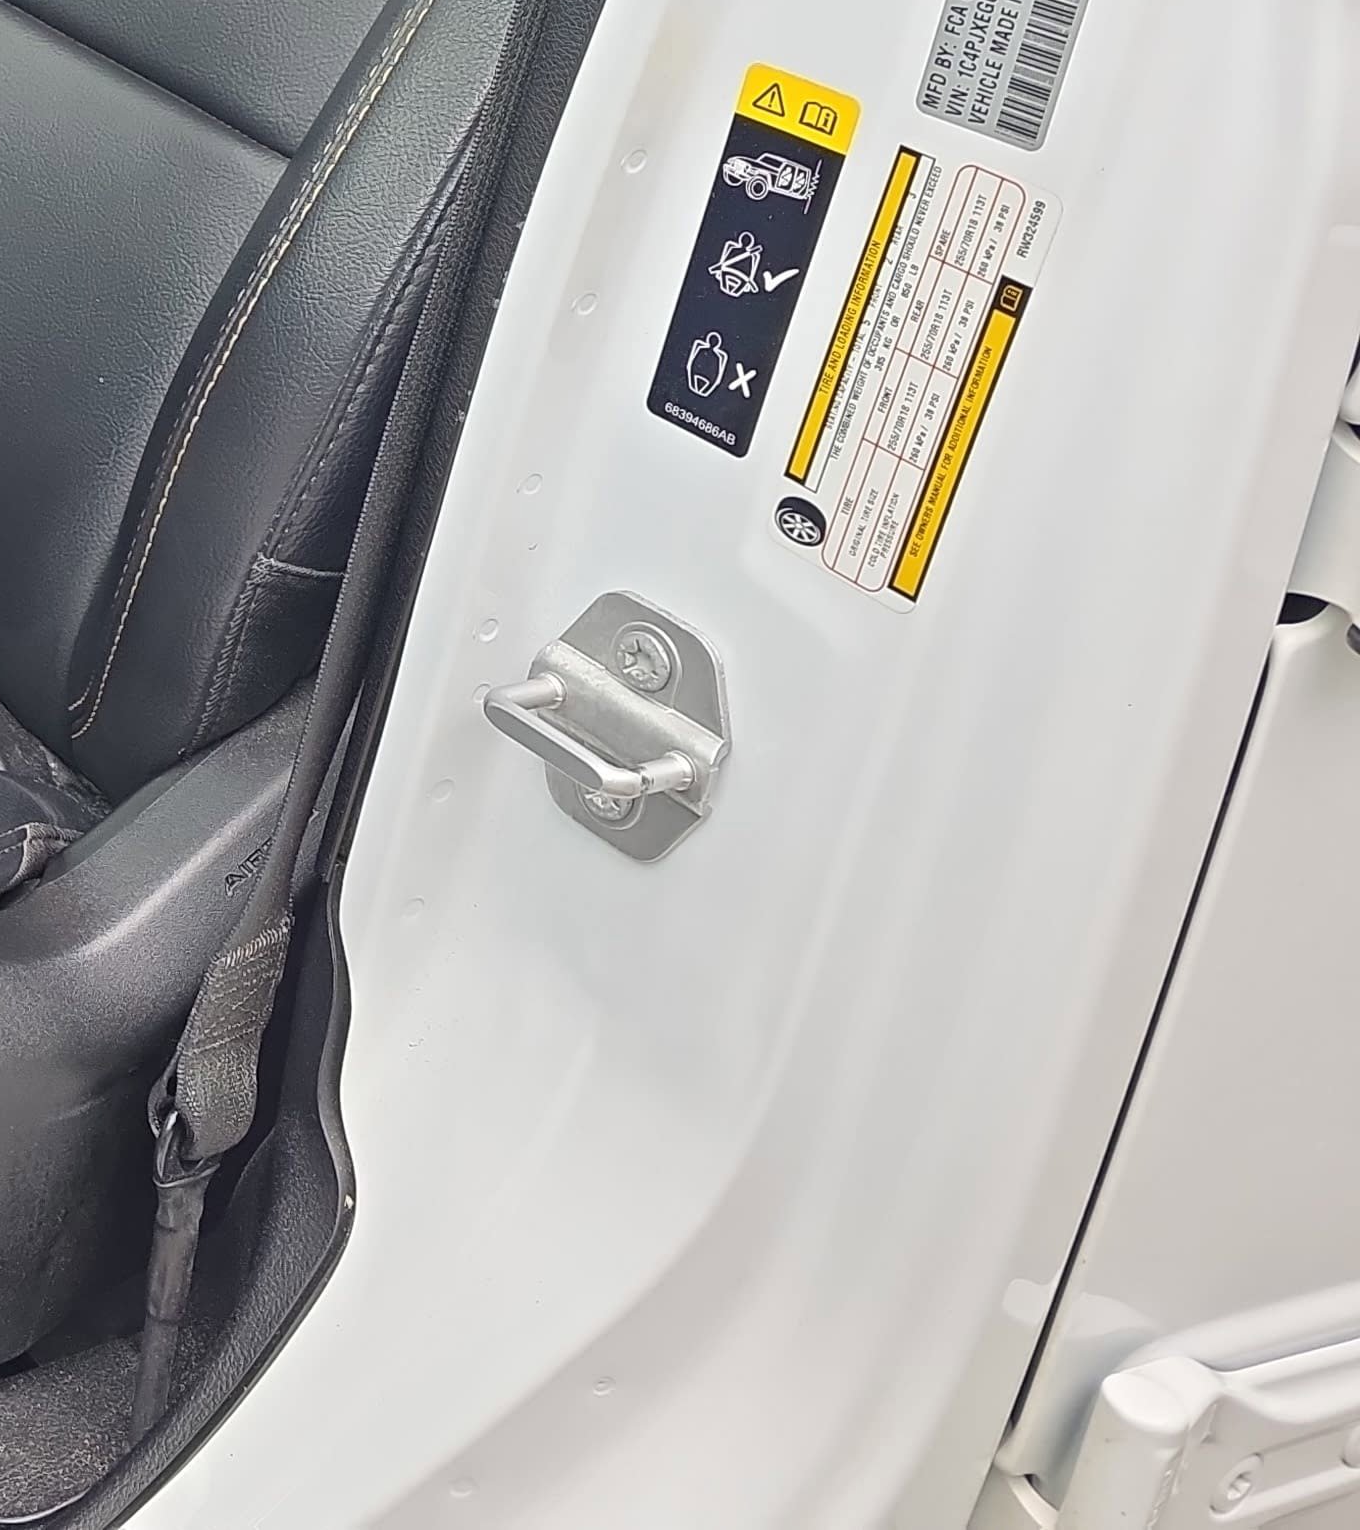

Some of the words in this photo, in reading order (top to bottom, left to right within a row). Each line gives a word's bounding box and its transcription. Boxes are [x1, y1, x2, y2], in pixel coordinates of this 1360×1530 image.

[943, 5, 969, 36] FCA
[934, 42, 957, 70] BY:
[967, 58, 1004, 125] VEHICLE
[989, 6, 1019, 56] MADE
[921, 72, 947, 110] MFD
[944, 84, 970, 116] VIN:
[934, 228, 951, 258] SPARE
[953, 218, 979, 267] 255/70R18
[971, 193, 988, 217] 113T
[1016, 200, 1046, 259] RW324599
[848, 237, 882, 307] INFORMATION
[834, 304, 857, 350] LOADING
[909, 299, 925, 323] REAR
[919, 312, 944, 361] 255/70R18
[937, 288, 953, 311] 113T
[827, 350, 842, 373] AND
[964, 345, 993, 404] INFORMATION
[818, 371, 835, 395] TIRE
[876, 386, 893, 414] FRONT
[664, 401, 737, 446] 68394686AB
[834, 400, 857, 444] COMBINED
[886, 404, 911, 452] 255/70R18
[904, 381, 919, 403] 113T
[947, 405, 973, 453] ADDITIONAL
[828, 441, 843, 461] THE
[940, 452, 954, 471] FOR
[840, 496, 854, 516] TIRE
[927, 472, 947, 507] MANUAL
[914, 505, 934, 541] OWNERS
[908, 540, 922, 558] SEE
